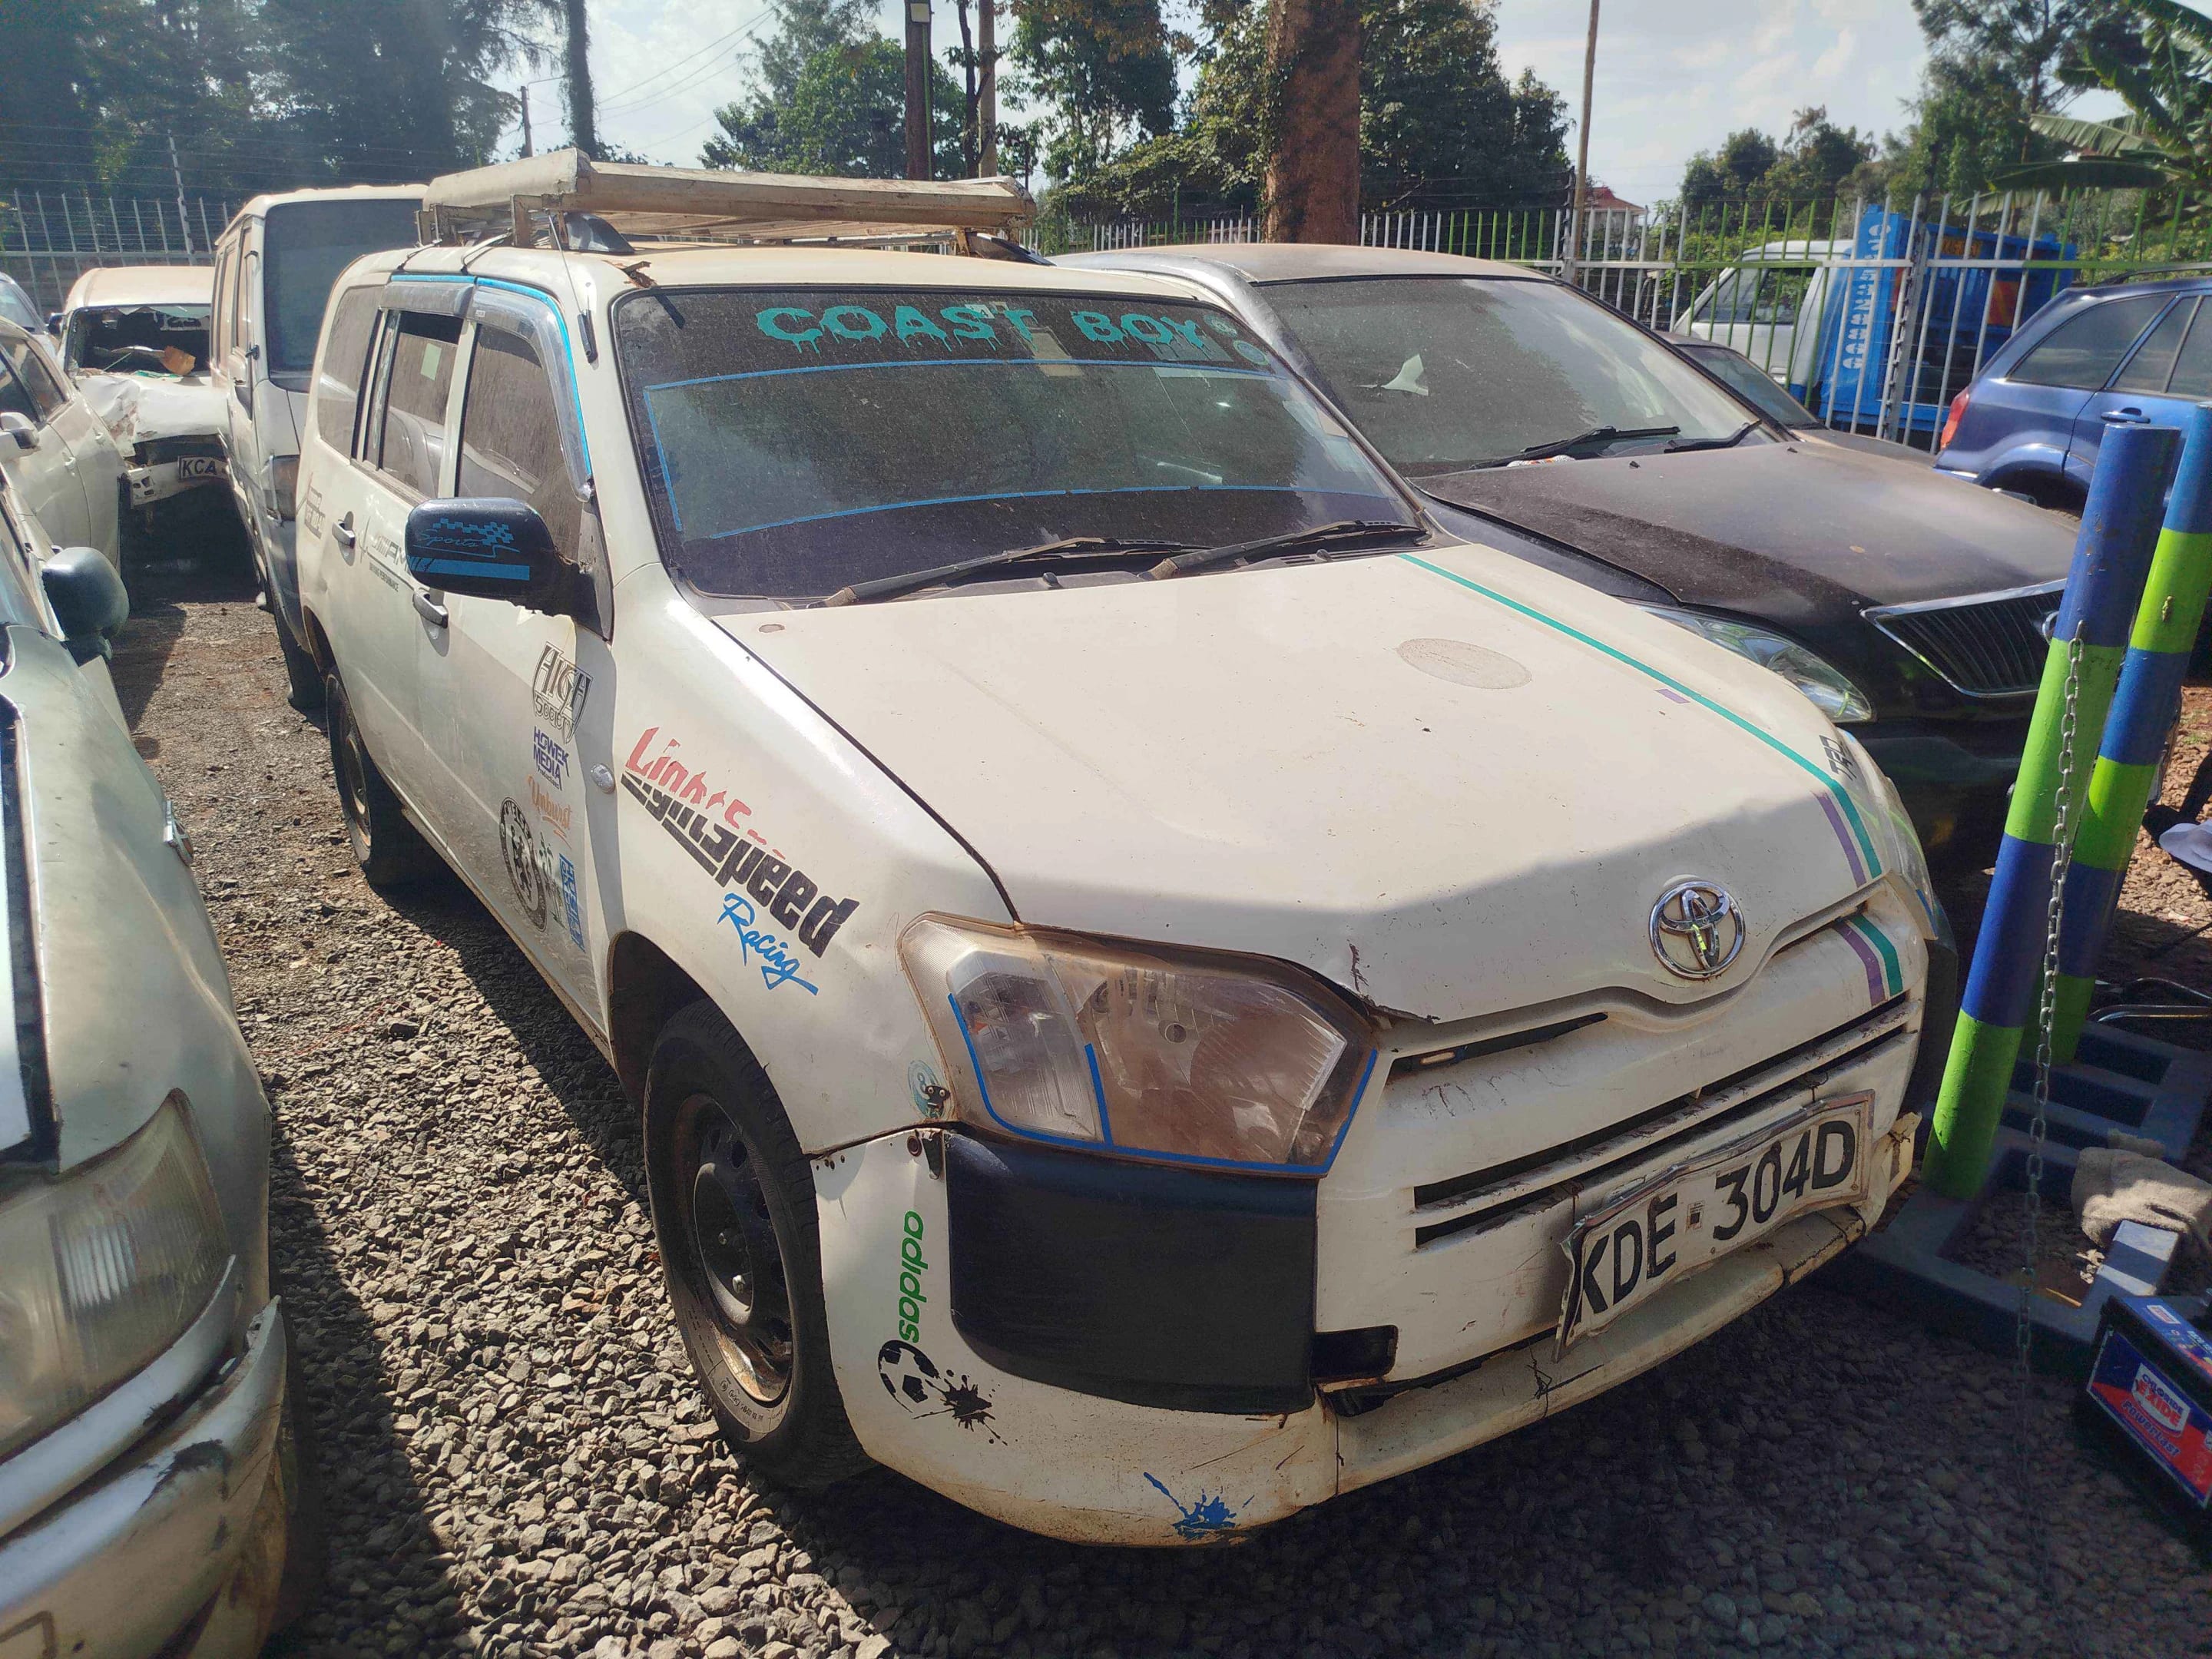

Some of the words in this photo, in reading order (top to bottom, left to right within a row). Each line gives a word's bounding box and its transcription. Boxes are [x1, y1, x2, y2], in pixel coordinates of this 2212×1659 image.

[757, 304, 1035, 353] COAST
[1071, 310, 1207, 350] BOY
[182, 459, 217, 477] KCA
[534, 743, 562, 791] MEDIA
[717, 892, 819, 995] Racing
[1575, 1193, 1678, 1320] KDE
[1713, 1120, 1856, 1241] 304D
[899, 1209, 927, 1343] adidas
[2137, 1379, 2183, 1426] EXIDE
